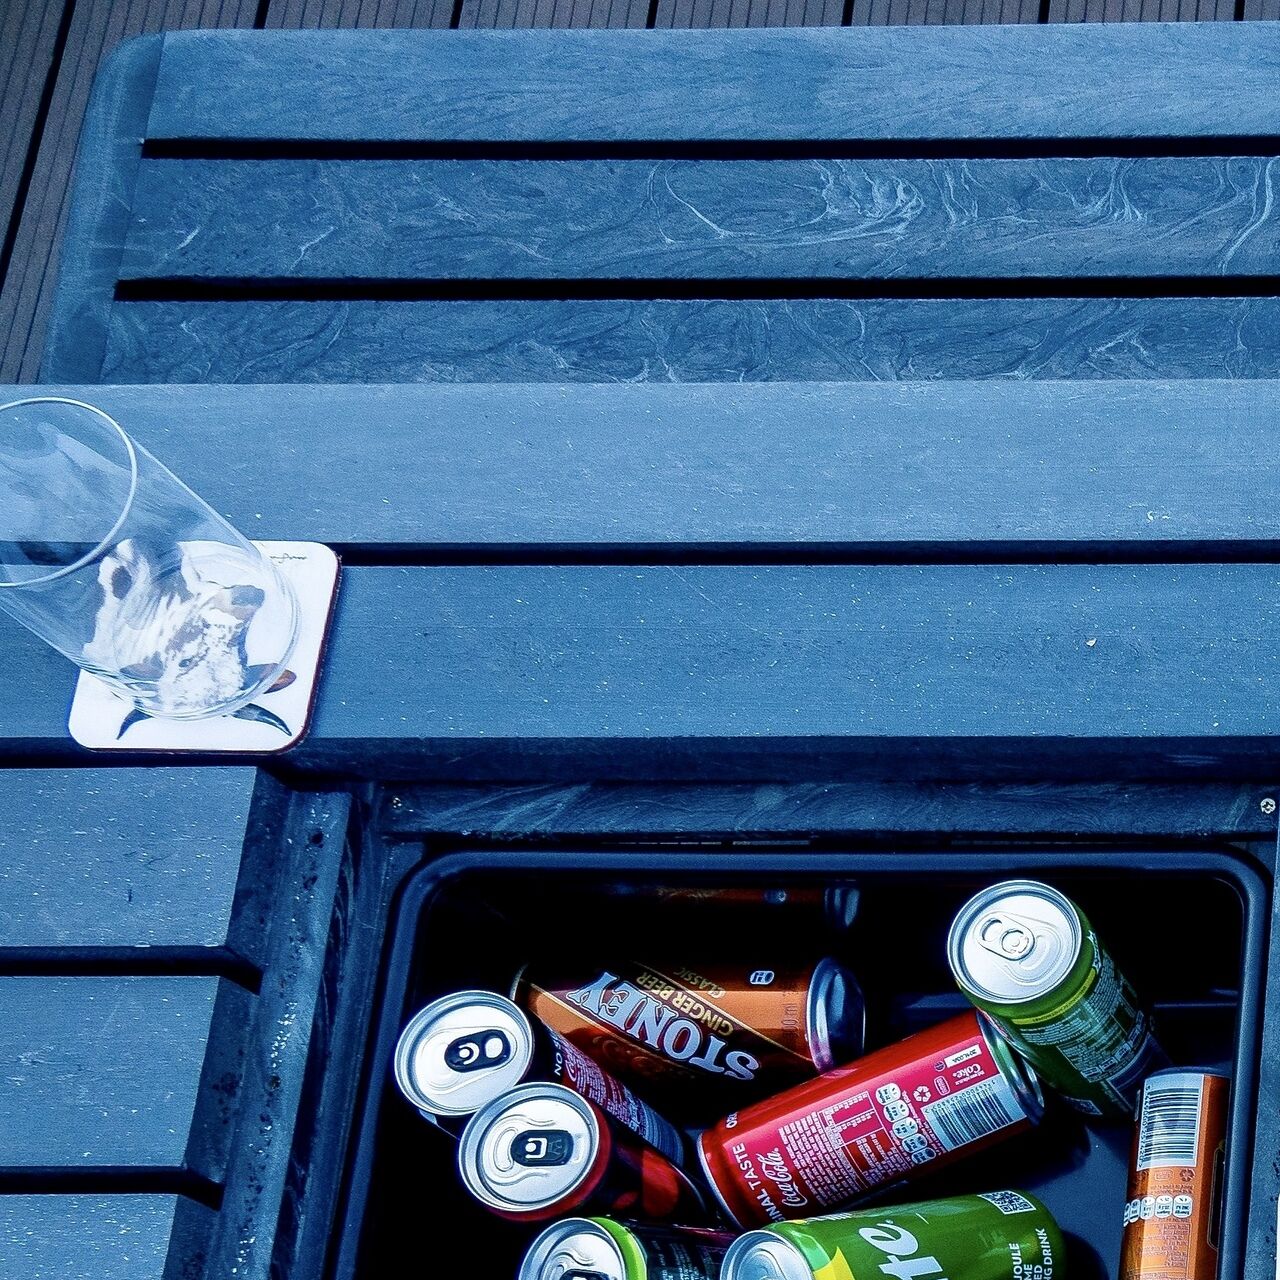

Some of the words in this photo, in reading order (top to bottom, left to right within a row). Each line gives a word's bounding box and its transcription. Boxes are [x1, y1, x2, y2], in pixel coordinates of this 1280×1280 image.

[635, 971, 677, 1001] BEER
[565, 971, 761, 1081] STONEY
[672, 992, 734, 1036] GINGER
[952, 1063, 981, 1079] Coke
[732, 1142, 759, 1190] TASTE
[1035, 1228, 1052, 1265] DRINK
